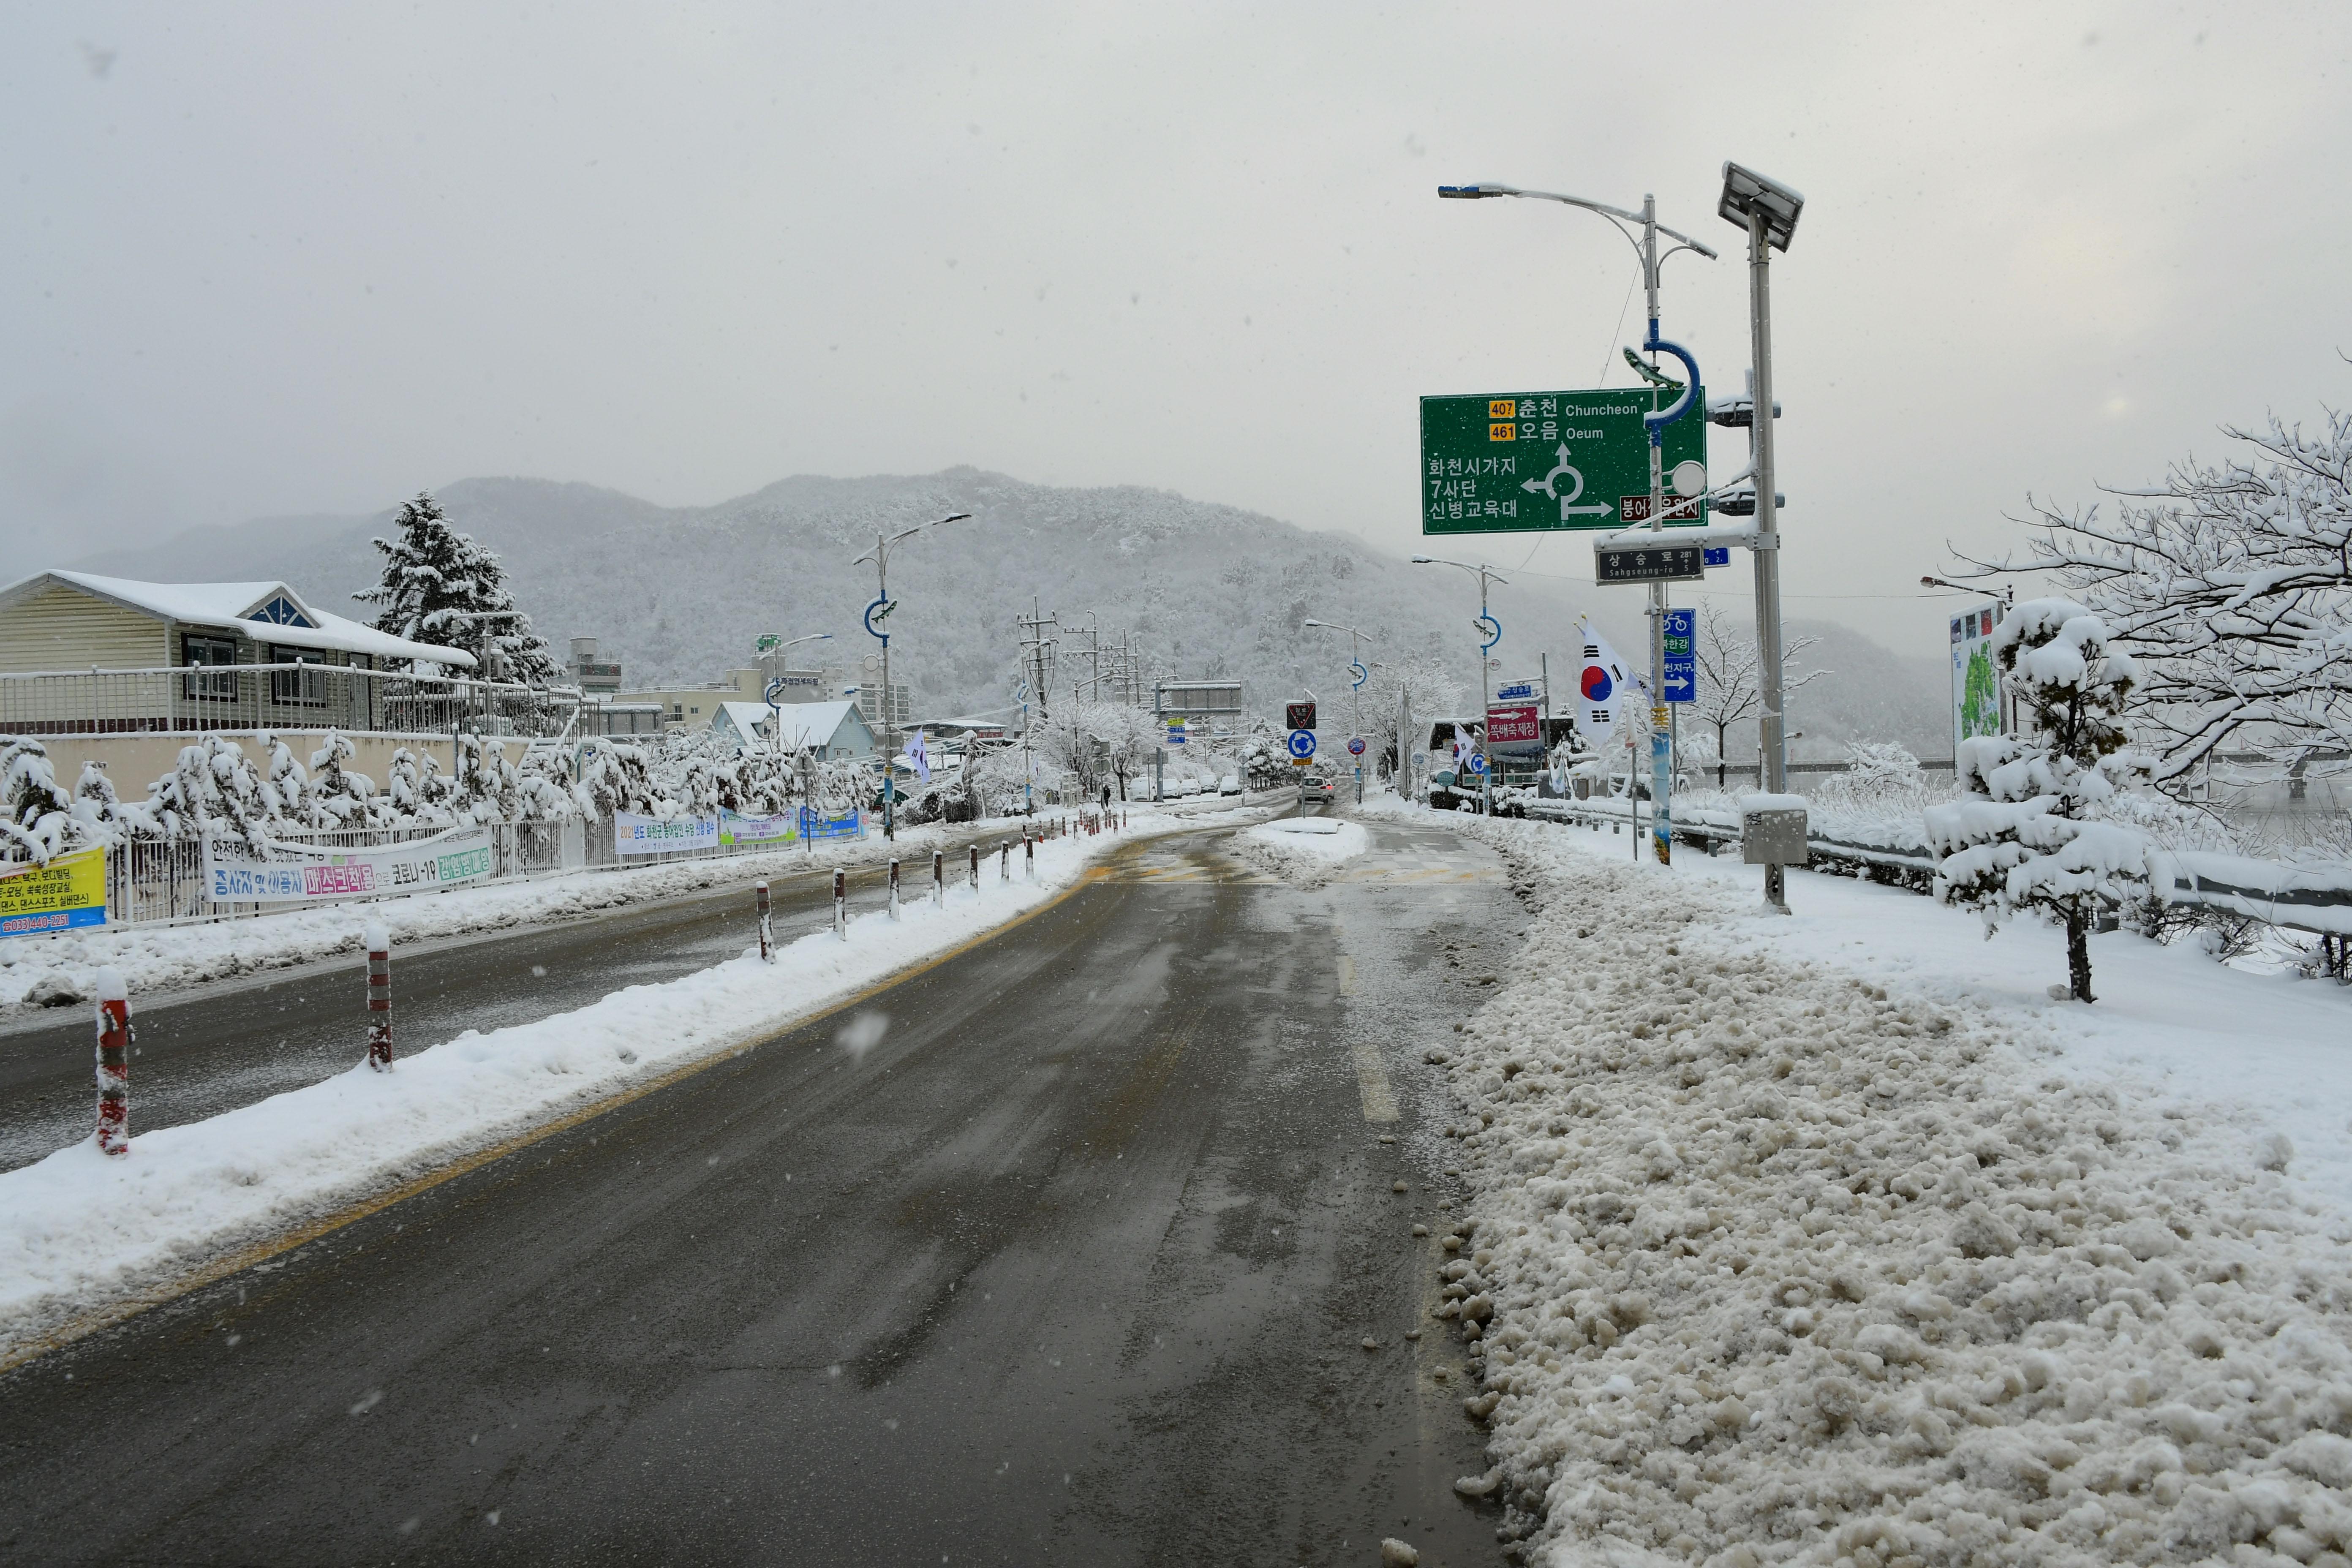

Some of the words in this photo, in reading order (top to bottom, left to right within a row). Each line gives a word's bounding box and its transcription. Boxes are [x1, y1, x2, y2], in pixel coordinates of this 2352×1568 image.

[1492, 403, 1513, 414] 407
[1519, 398, 1557, 418] 춘천
[1565, 404, 1638, 416] Chuncheon
[1492, 426, 1514, 438] 461
[1520, 421, 1559, 440] 오음
[1566, 428, 1603, 439] Oeum
[1429, 456, 1515, 476] 화천시가지
[1431, 479, 1476, 498] 7사단
[1429, 499, 1516, 520] 신병교육대
[1622, 497, 1697, 518] 붕어유원지
[1664, 663, 1692, 673] 천지구
[1490, 721, 1535, 739] 쪽배축제장
[621, 825, 645, 839] 2021년도
[647, 825, 662, 839] 화천군
[42, 868, 73, 881] 보디빌딩,
[215, 870, 252, 895] 종사자
[256, 874, 266, 894] 및
[268, 870, 302, 894] 이용자
[392, 860, 436, 885] 코로나-19
[0, 900, 18, 912] 댄스,
[20, 896, 57, 911] 댄스스포츠,
[60, 893, 89, 907] 실버댄스)
[12, 915, 69, 931] 033)440-2251
